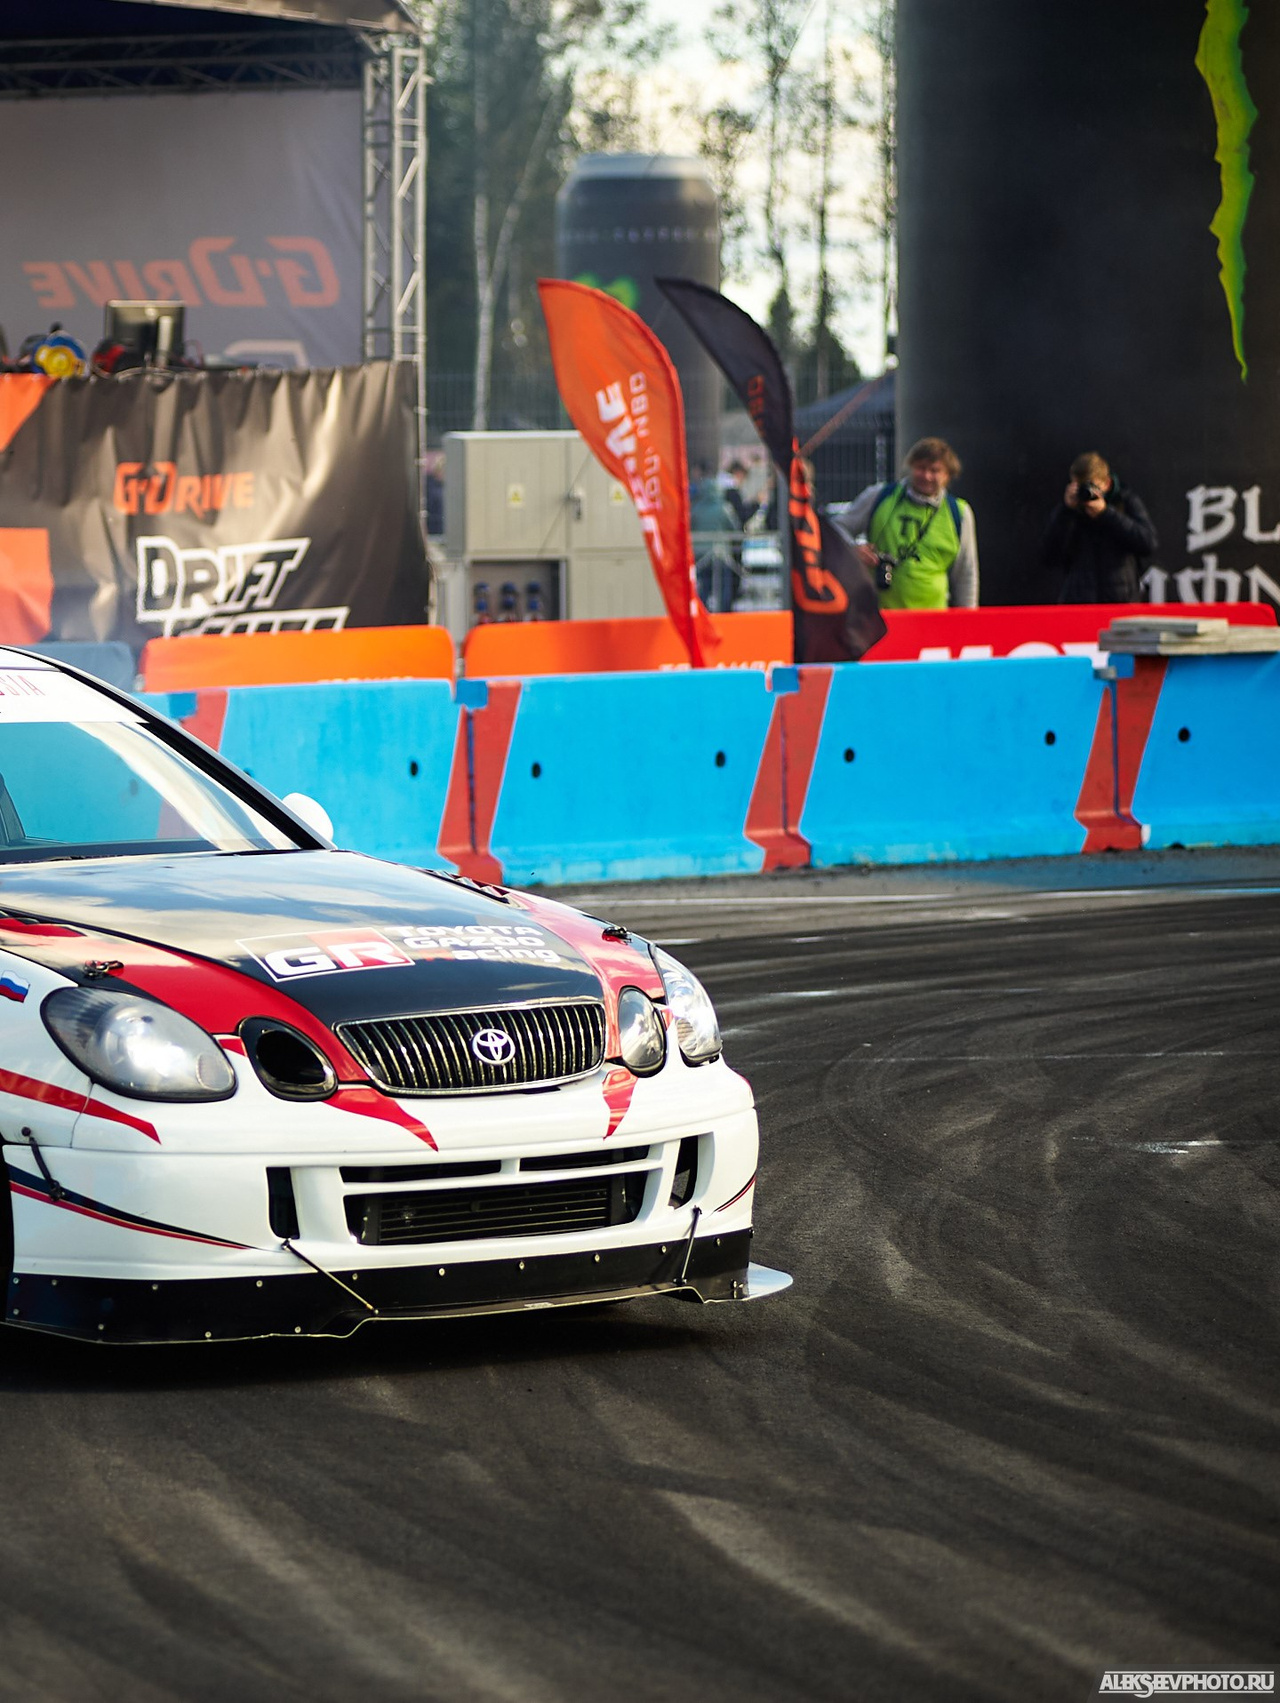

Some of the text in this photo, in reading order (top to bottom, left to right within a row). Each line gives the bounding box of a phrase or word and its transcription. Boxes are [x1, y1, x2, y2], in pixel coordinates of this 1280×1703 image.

[136, 535, 312, 622] DRIFT
[384, 925, 544, 937] TOYOTA
[403, 936, 546, 949] GAZOO
[264, 940, 406, 977] GR
